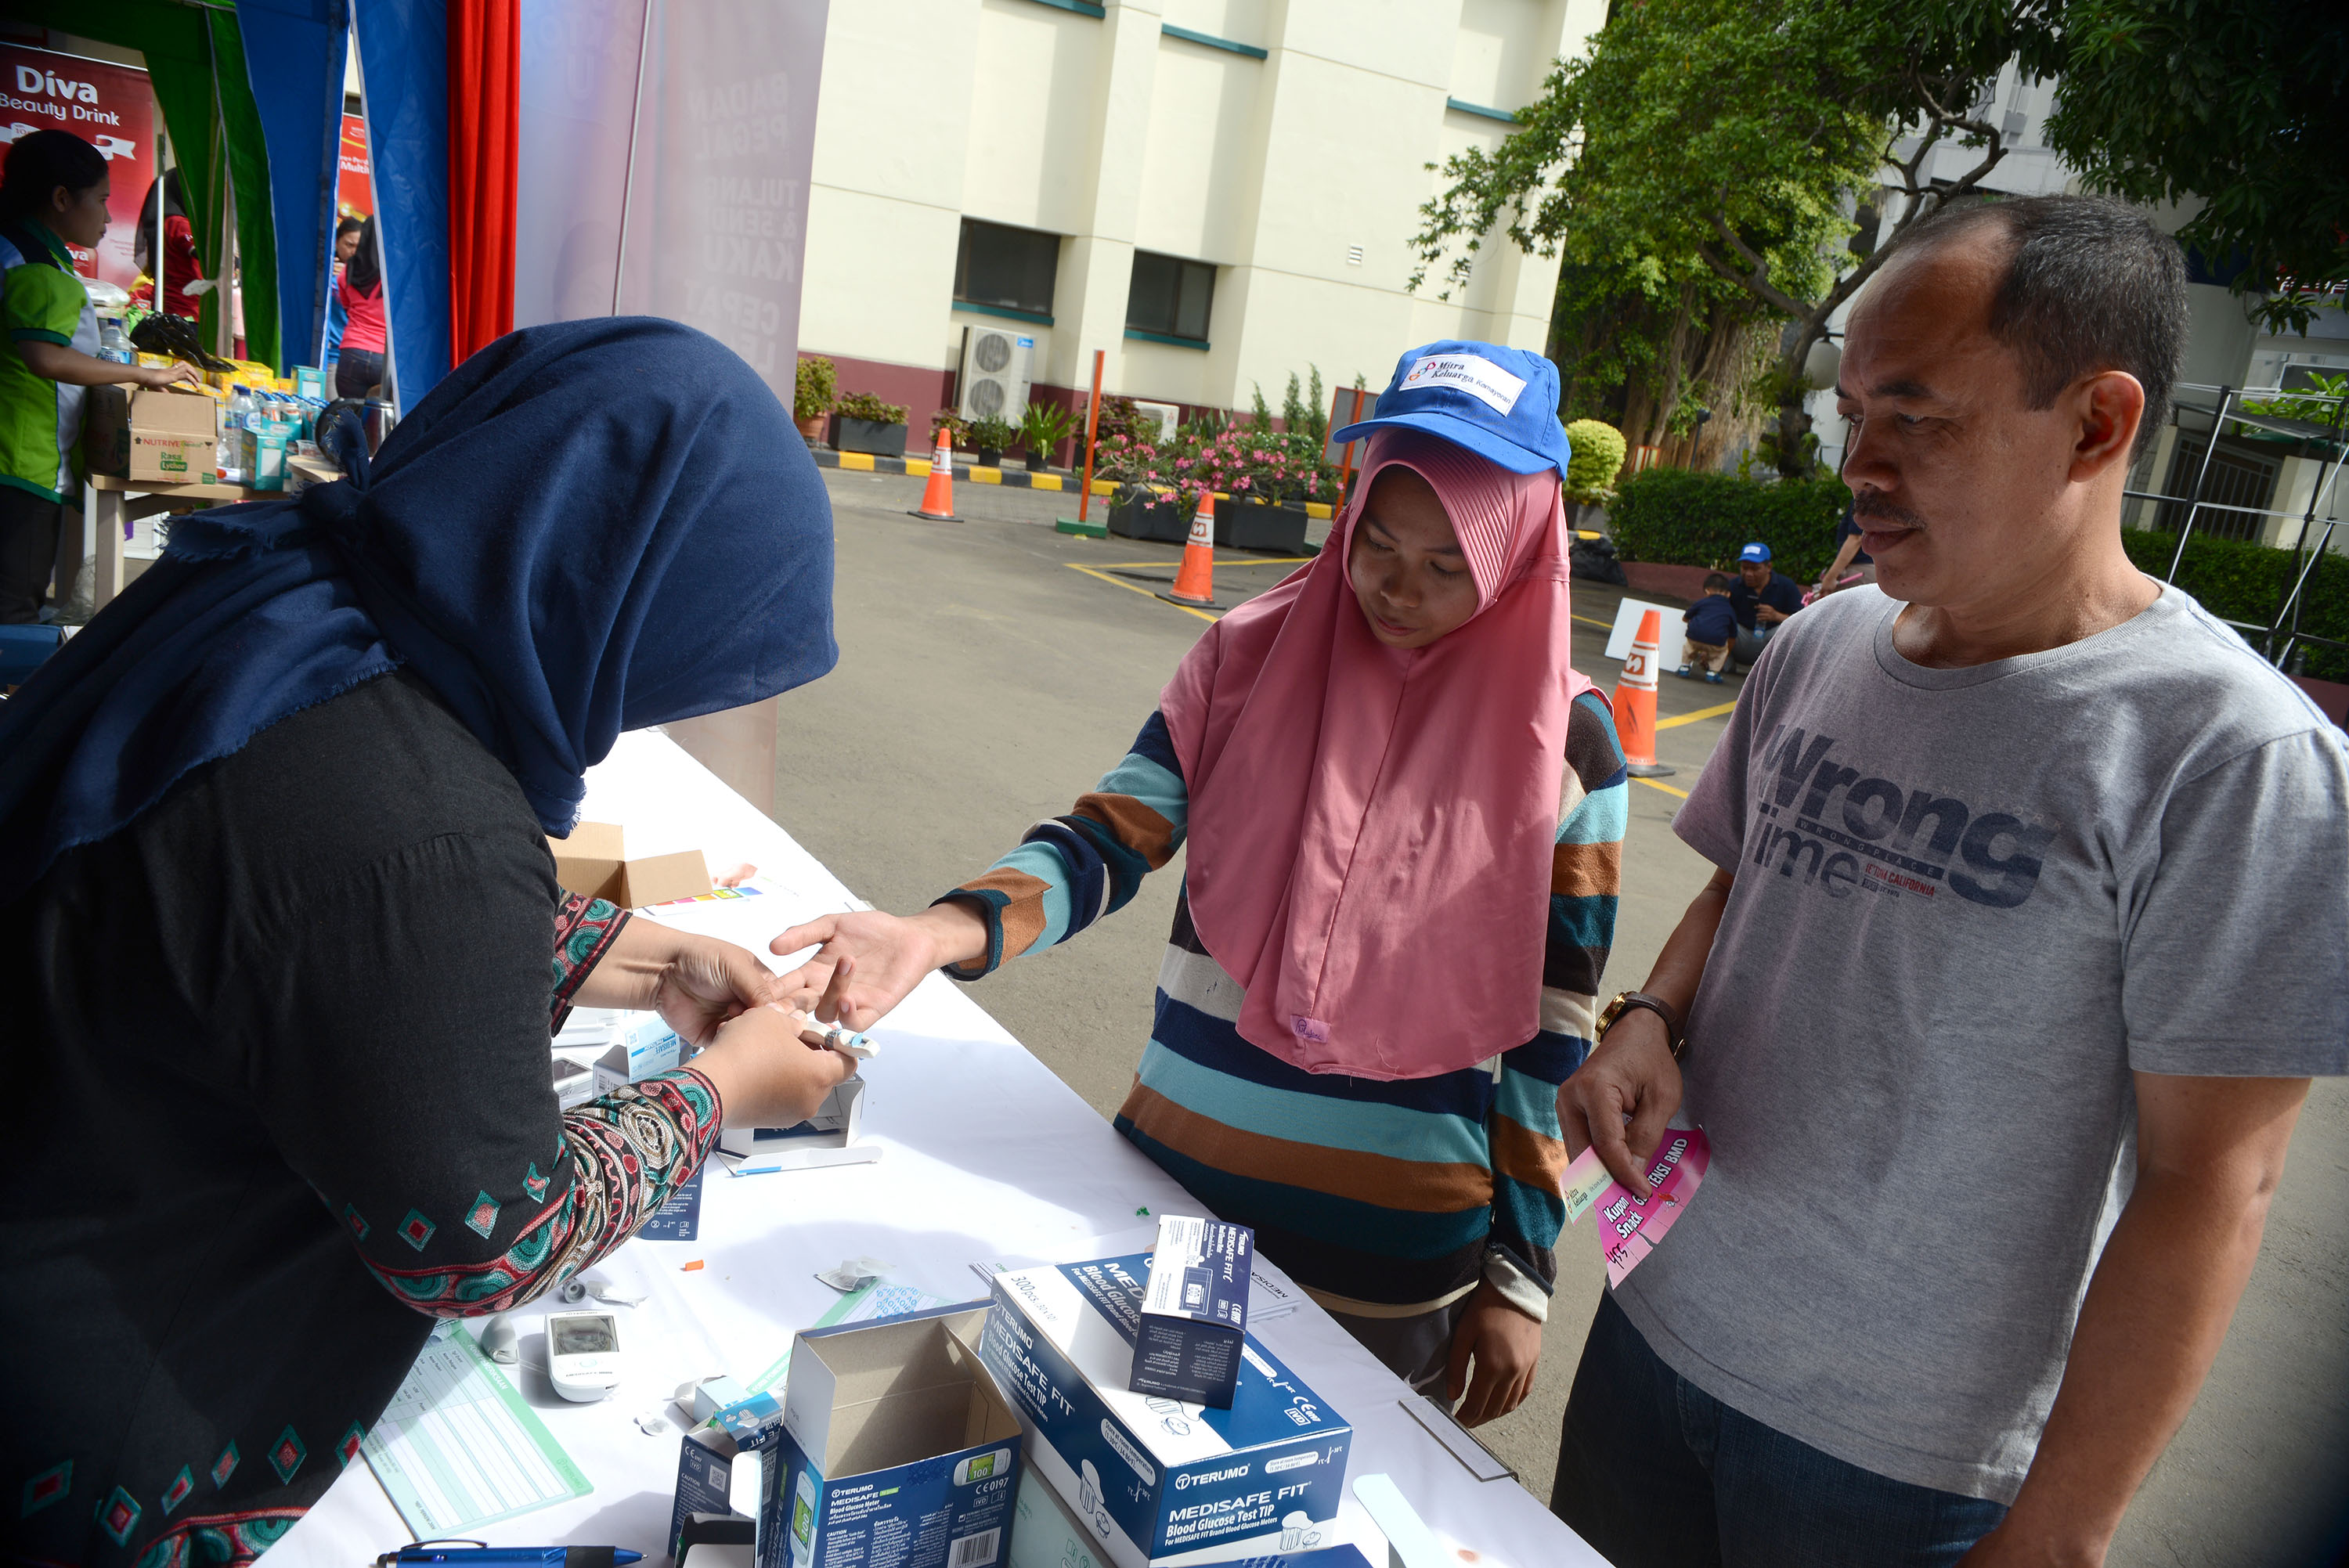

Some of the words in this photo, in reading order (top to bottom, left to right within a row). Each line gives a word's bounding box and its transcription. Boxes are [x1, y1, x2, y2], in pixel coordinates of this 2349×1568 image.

[0, 92, 67, 121] Beauty
[73, 104, 120, 126] Drink
[1431, 369, 1474, 383] Keluarga
[1438, 361, 1465, 371] Mitra
[161, 452, 182, 461] Rasa
[1759, 724, 2057, 909] Wrong
[1888, 872, 1936, 897] CALIFORNIA
[1664, 1137, 1689, 1165] BMD
[1603, 1195, 1630, 1223] Kupon
[1615, 1210, 1644, 1239] Snack
[1225, 1226, 1237, 1263] MEDISAFE
[1224, 1263, 1232, 1278] FIT
[1082, 1265, 1117, 1291] Blood
[1107, 1291, 1141, 1324] Glucose
[1251, 1271, 1289, 1298] MEDISA
[1001, 1305, 1034, 1350] TERUMO
[988, 1329, 1003, 1357] Blood
[1002, 1348, 1024, 1381] Glucose
[1024, 1372, 1037, 1396] Test
[1037, 1389, 1047, 1407] TIP
[990, 1314, 1048, 1391] MEDISAFE
[1051, 1386, 1073, 1416] FIT
[1288, 1409, 1307, 1424] IVD
[750, 1434, 766, 1448] FIT
[681, 1472, 701, 1487] CAUTION
[973, 1467, 988, 1479] 100
[990, 1477, 1009, 1491] 0197
[1191, 1465, 1249, 1486] TERUMO
[831, 1491, 879, 1507] MEDISAFE
[839, 1483, 874, 1496] TERUMO
[830, 1506, 845, 1515] Blood
[845, 1502, 864, 1512] Glucose
[864, 1499, 880, 1508] Meter
[1169, 1491, 1272, 1522] MEDISAFE
[1278, 1483, 1308, 1500] FIT
[801, 1513, 810, 1537] 100
[1166, 1522, 1196, 1537] Blood
[1198, 1516, 1235, 1532] Glucose
[1237, 1509, 1257, 1523] Test
[1259, 1504, 1275, 1518] TIP
[1174, 1534, 1200, 1545] MEDISAFE
[1209, 1529, 1225, 1538] Brand
[1225, 1525, 1240, 1535] Blood
[1241, 1521, 1260, 1531] Glucose
[1260, 1517, 1278, 1527] Meters
